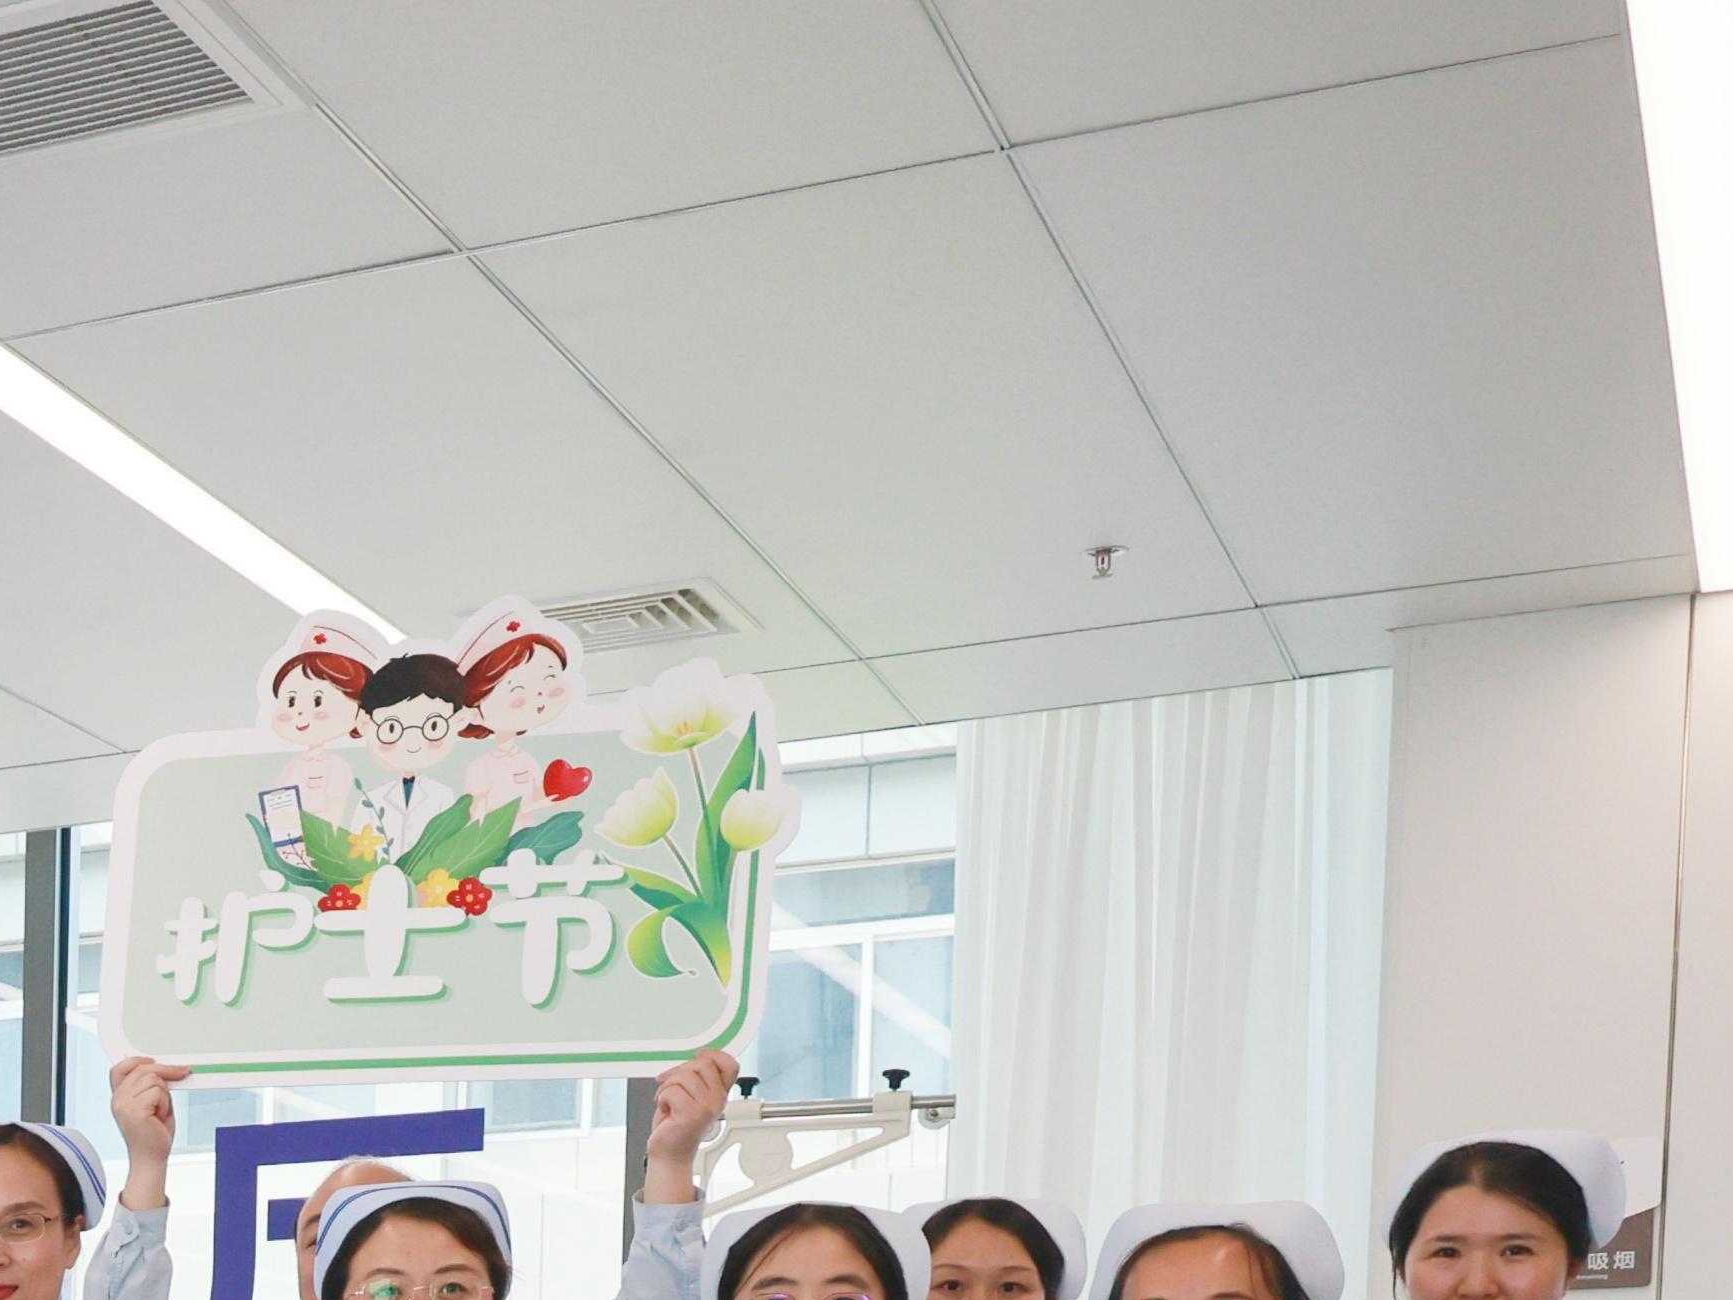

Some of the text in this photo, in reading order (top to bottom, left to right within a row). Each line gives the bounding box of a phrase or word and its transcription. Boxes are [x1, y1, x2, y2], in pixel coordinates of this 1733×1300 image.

[156, 849, 625, 1007] 护士节
[1587, 1251, 1635, 1270] 吸烟
